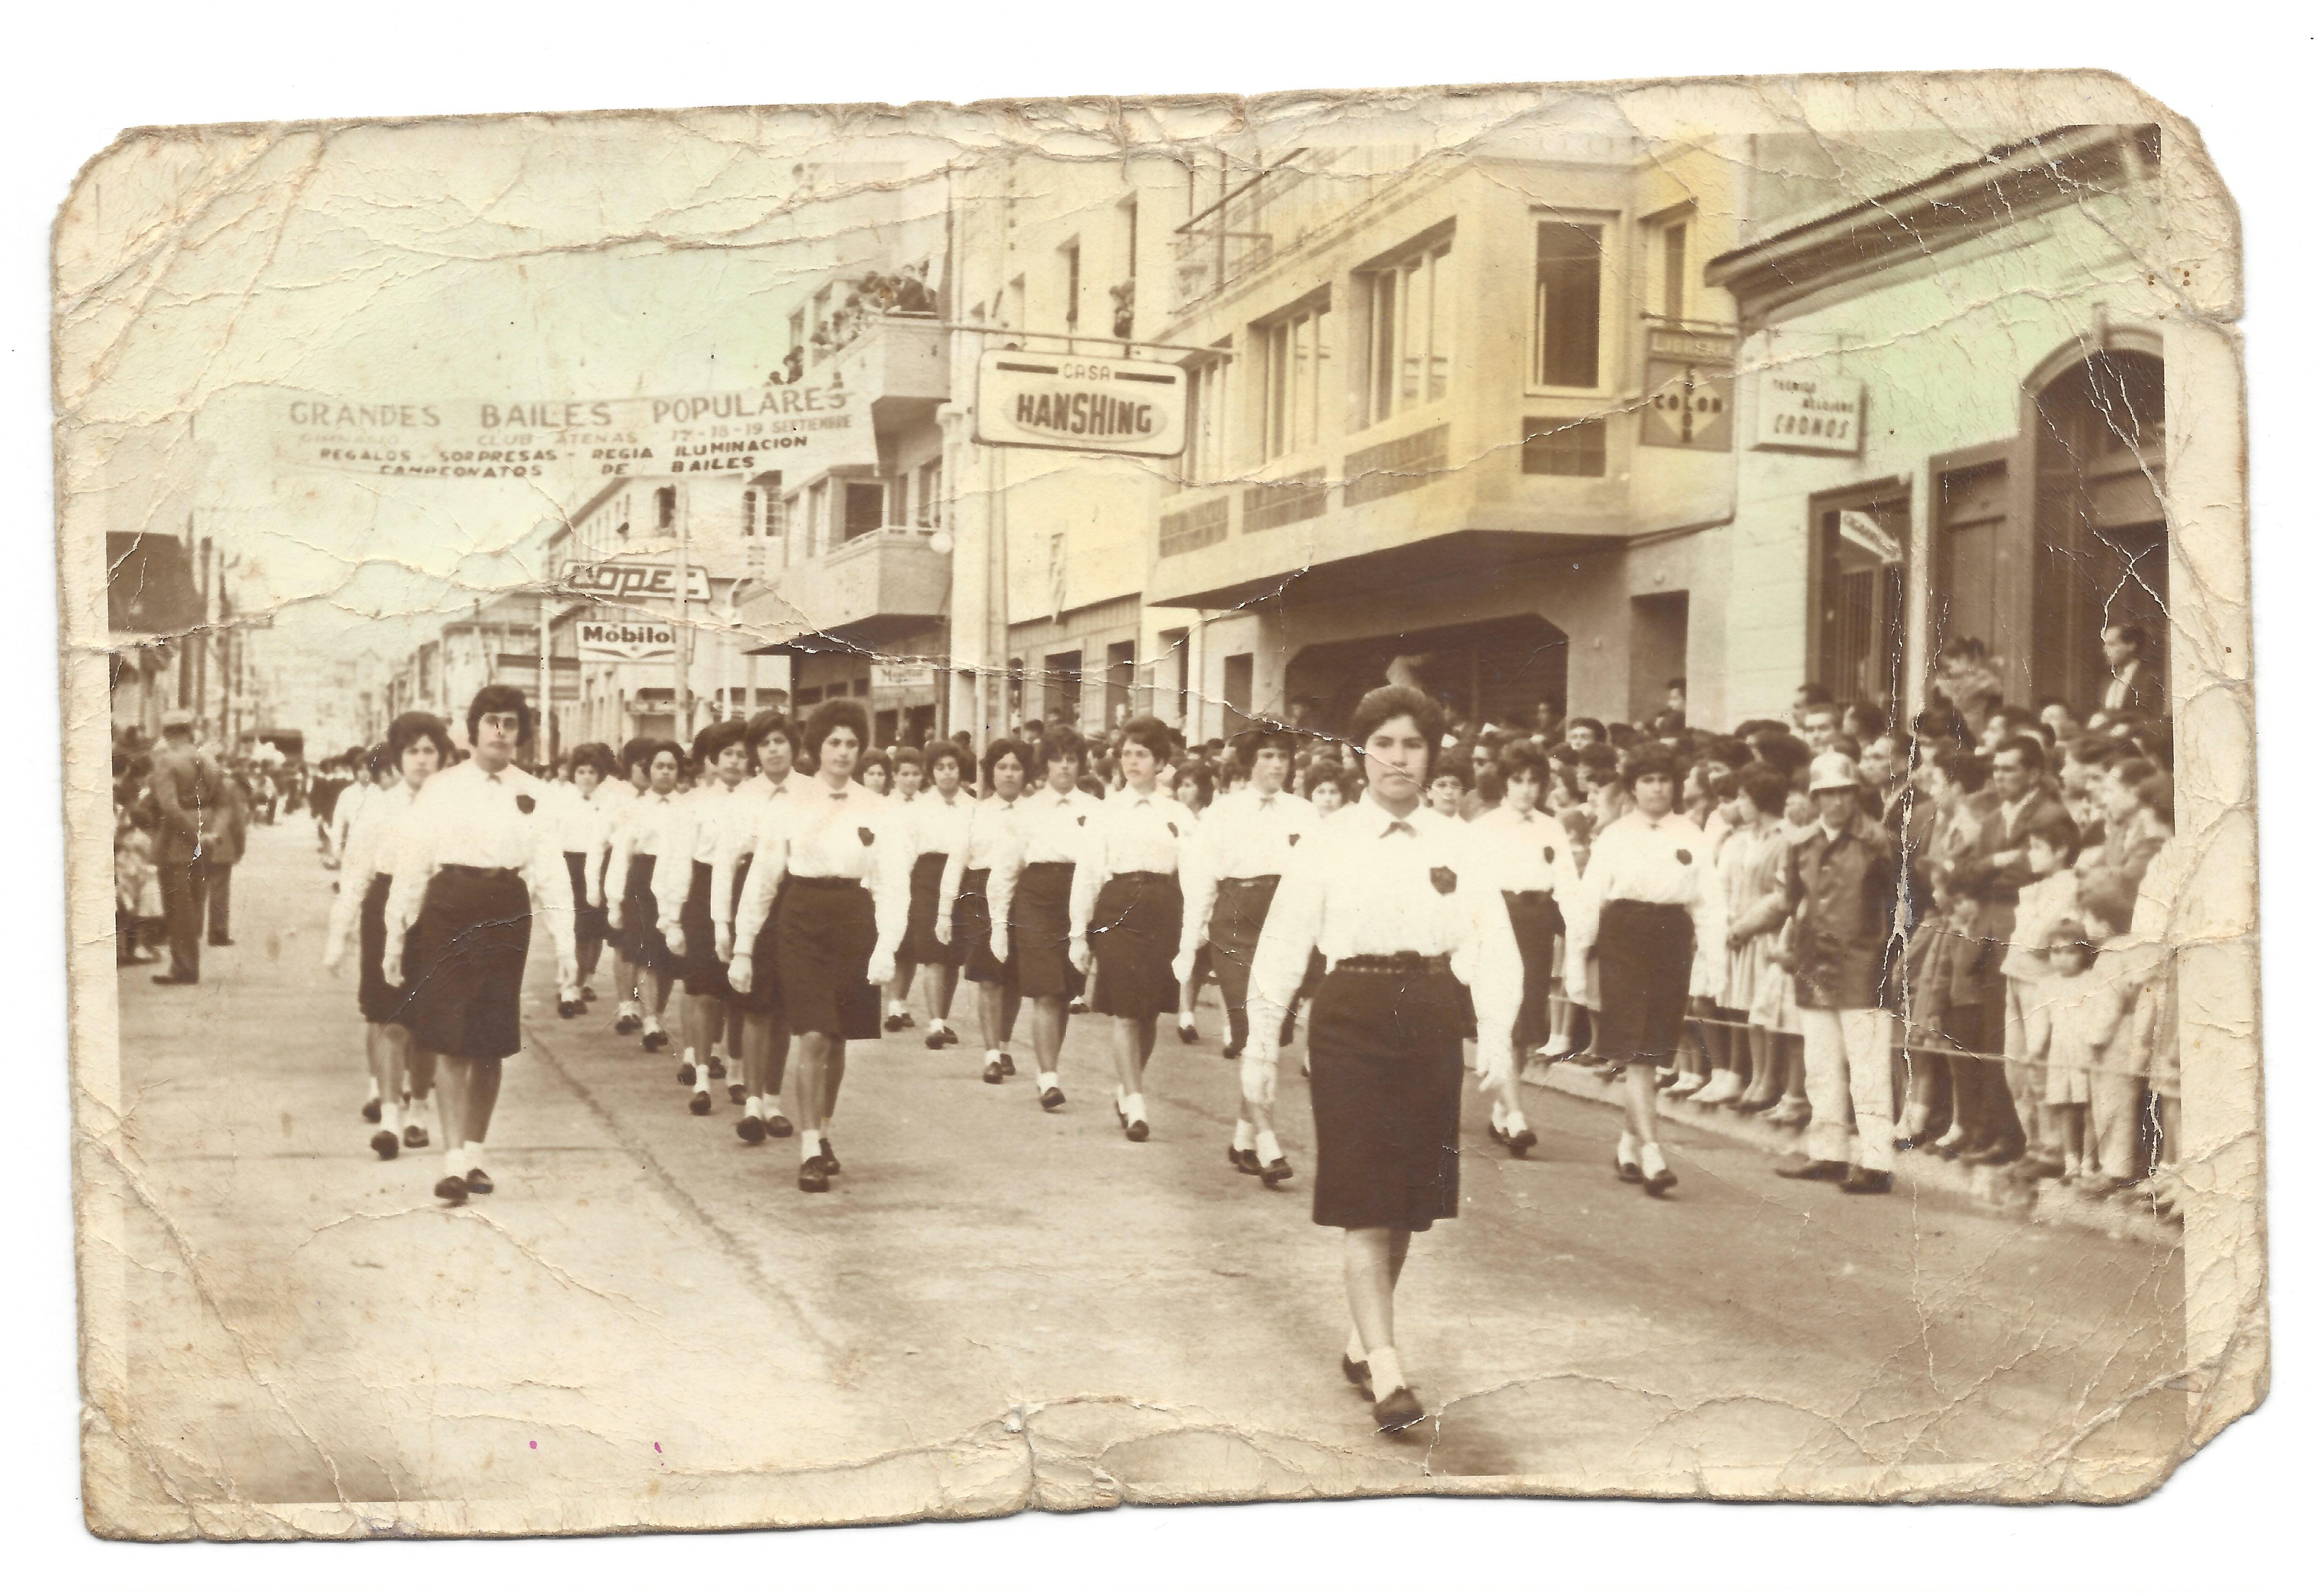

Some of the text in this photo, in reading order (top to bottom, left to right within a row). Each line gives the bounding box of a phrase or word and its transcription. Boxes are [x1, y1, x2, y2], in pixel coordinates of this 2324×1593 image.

[1063, 363, 1111, 381] CASA
[290, 387, 847, 428] GRANDES BAILES POPULARES
[1016, 392, 1152, 435] HANSHING
[477, 434, 532, 446] CLUB
[554, 432, 638, 445] ATENAS
[746, 422, 763, 435] 19
[772, 415, 852, 434] SEPTIEMBRE
[1775, 414, 1849, 439] CRONOS
[320, 448, 411, 461] REGALOS
[439, 449, 557, 462] SORPRESAS
[592, 447, 654, 460] REGIA
[675, 436, 808, 457] ILUMINACION
[380, 456, 755, 478] CAMPEONATOS DE BAILES
